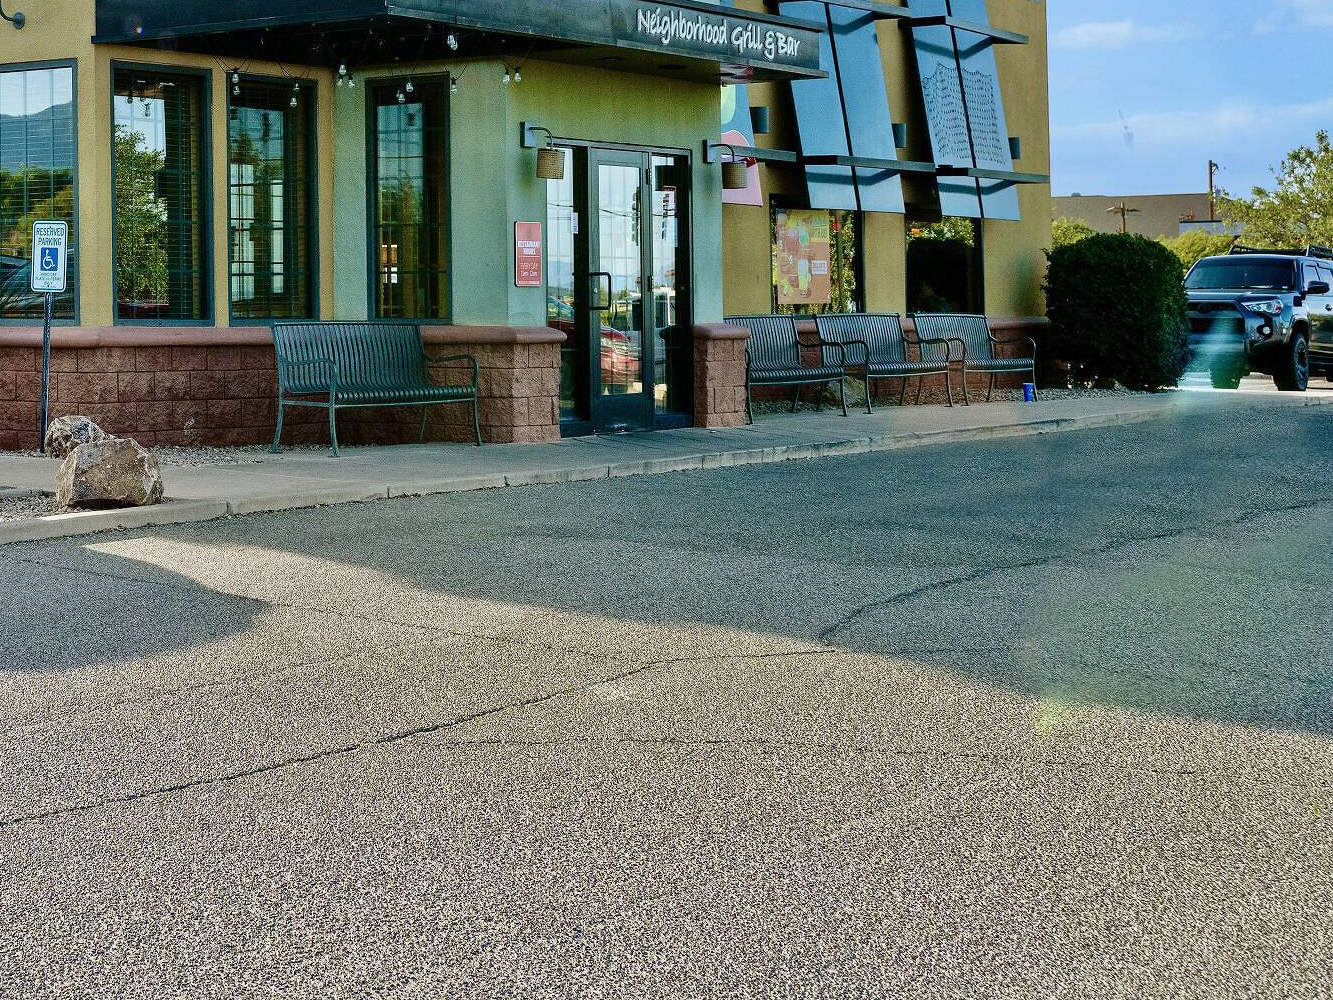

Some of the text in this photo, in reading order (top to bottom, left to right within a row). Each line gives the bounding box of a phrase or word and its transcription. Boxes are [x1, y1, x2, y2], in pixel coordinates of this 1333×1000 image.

[636, 7, 801, 59] Neighborhood Grill & Bar
[36, 227, 65, 237] RESERVED
[37, 238, 62, 246] PARKING
